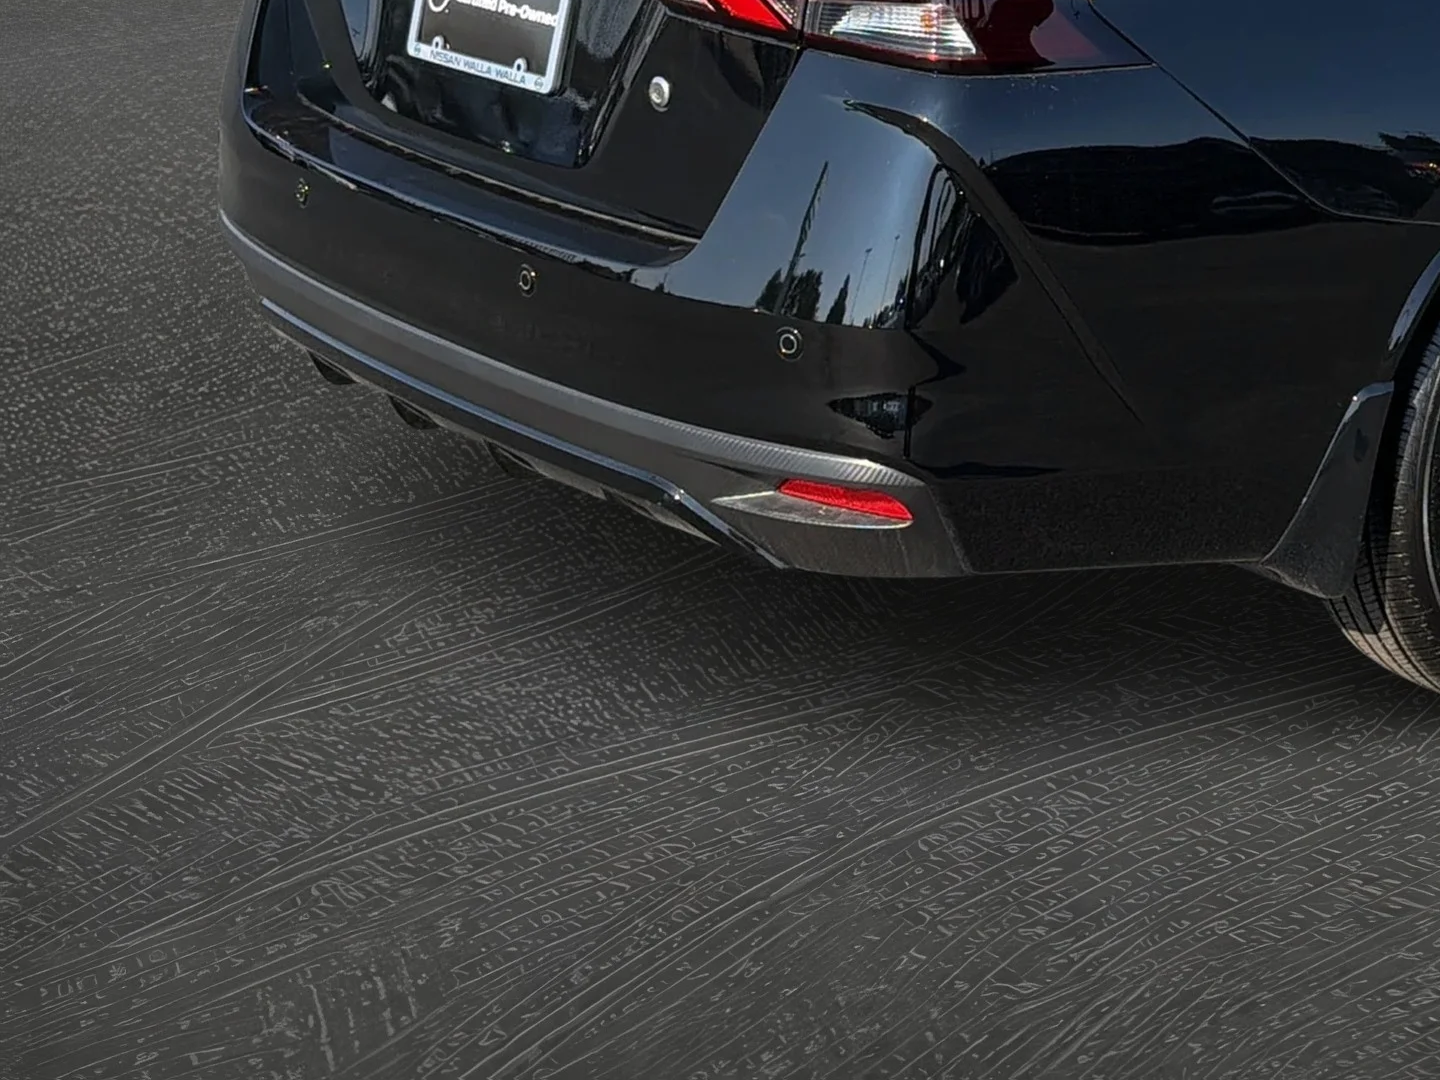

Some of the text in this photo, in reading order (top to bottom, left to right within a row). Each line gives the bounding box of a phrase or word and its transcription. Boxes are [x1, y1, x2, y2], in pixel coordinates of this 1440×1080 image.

[429, 50, 462, 67] NISSAN
[463, 58, 494, 76] WALLA
[494, 68, 527, 86] WALLA
